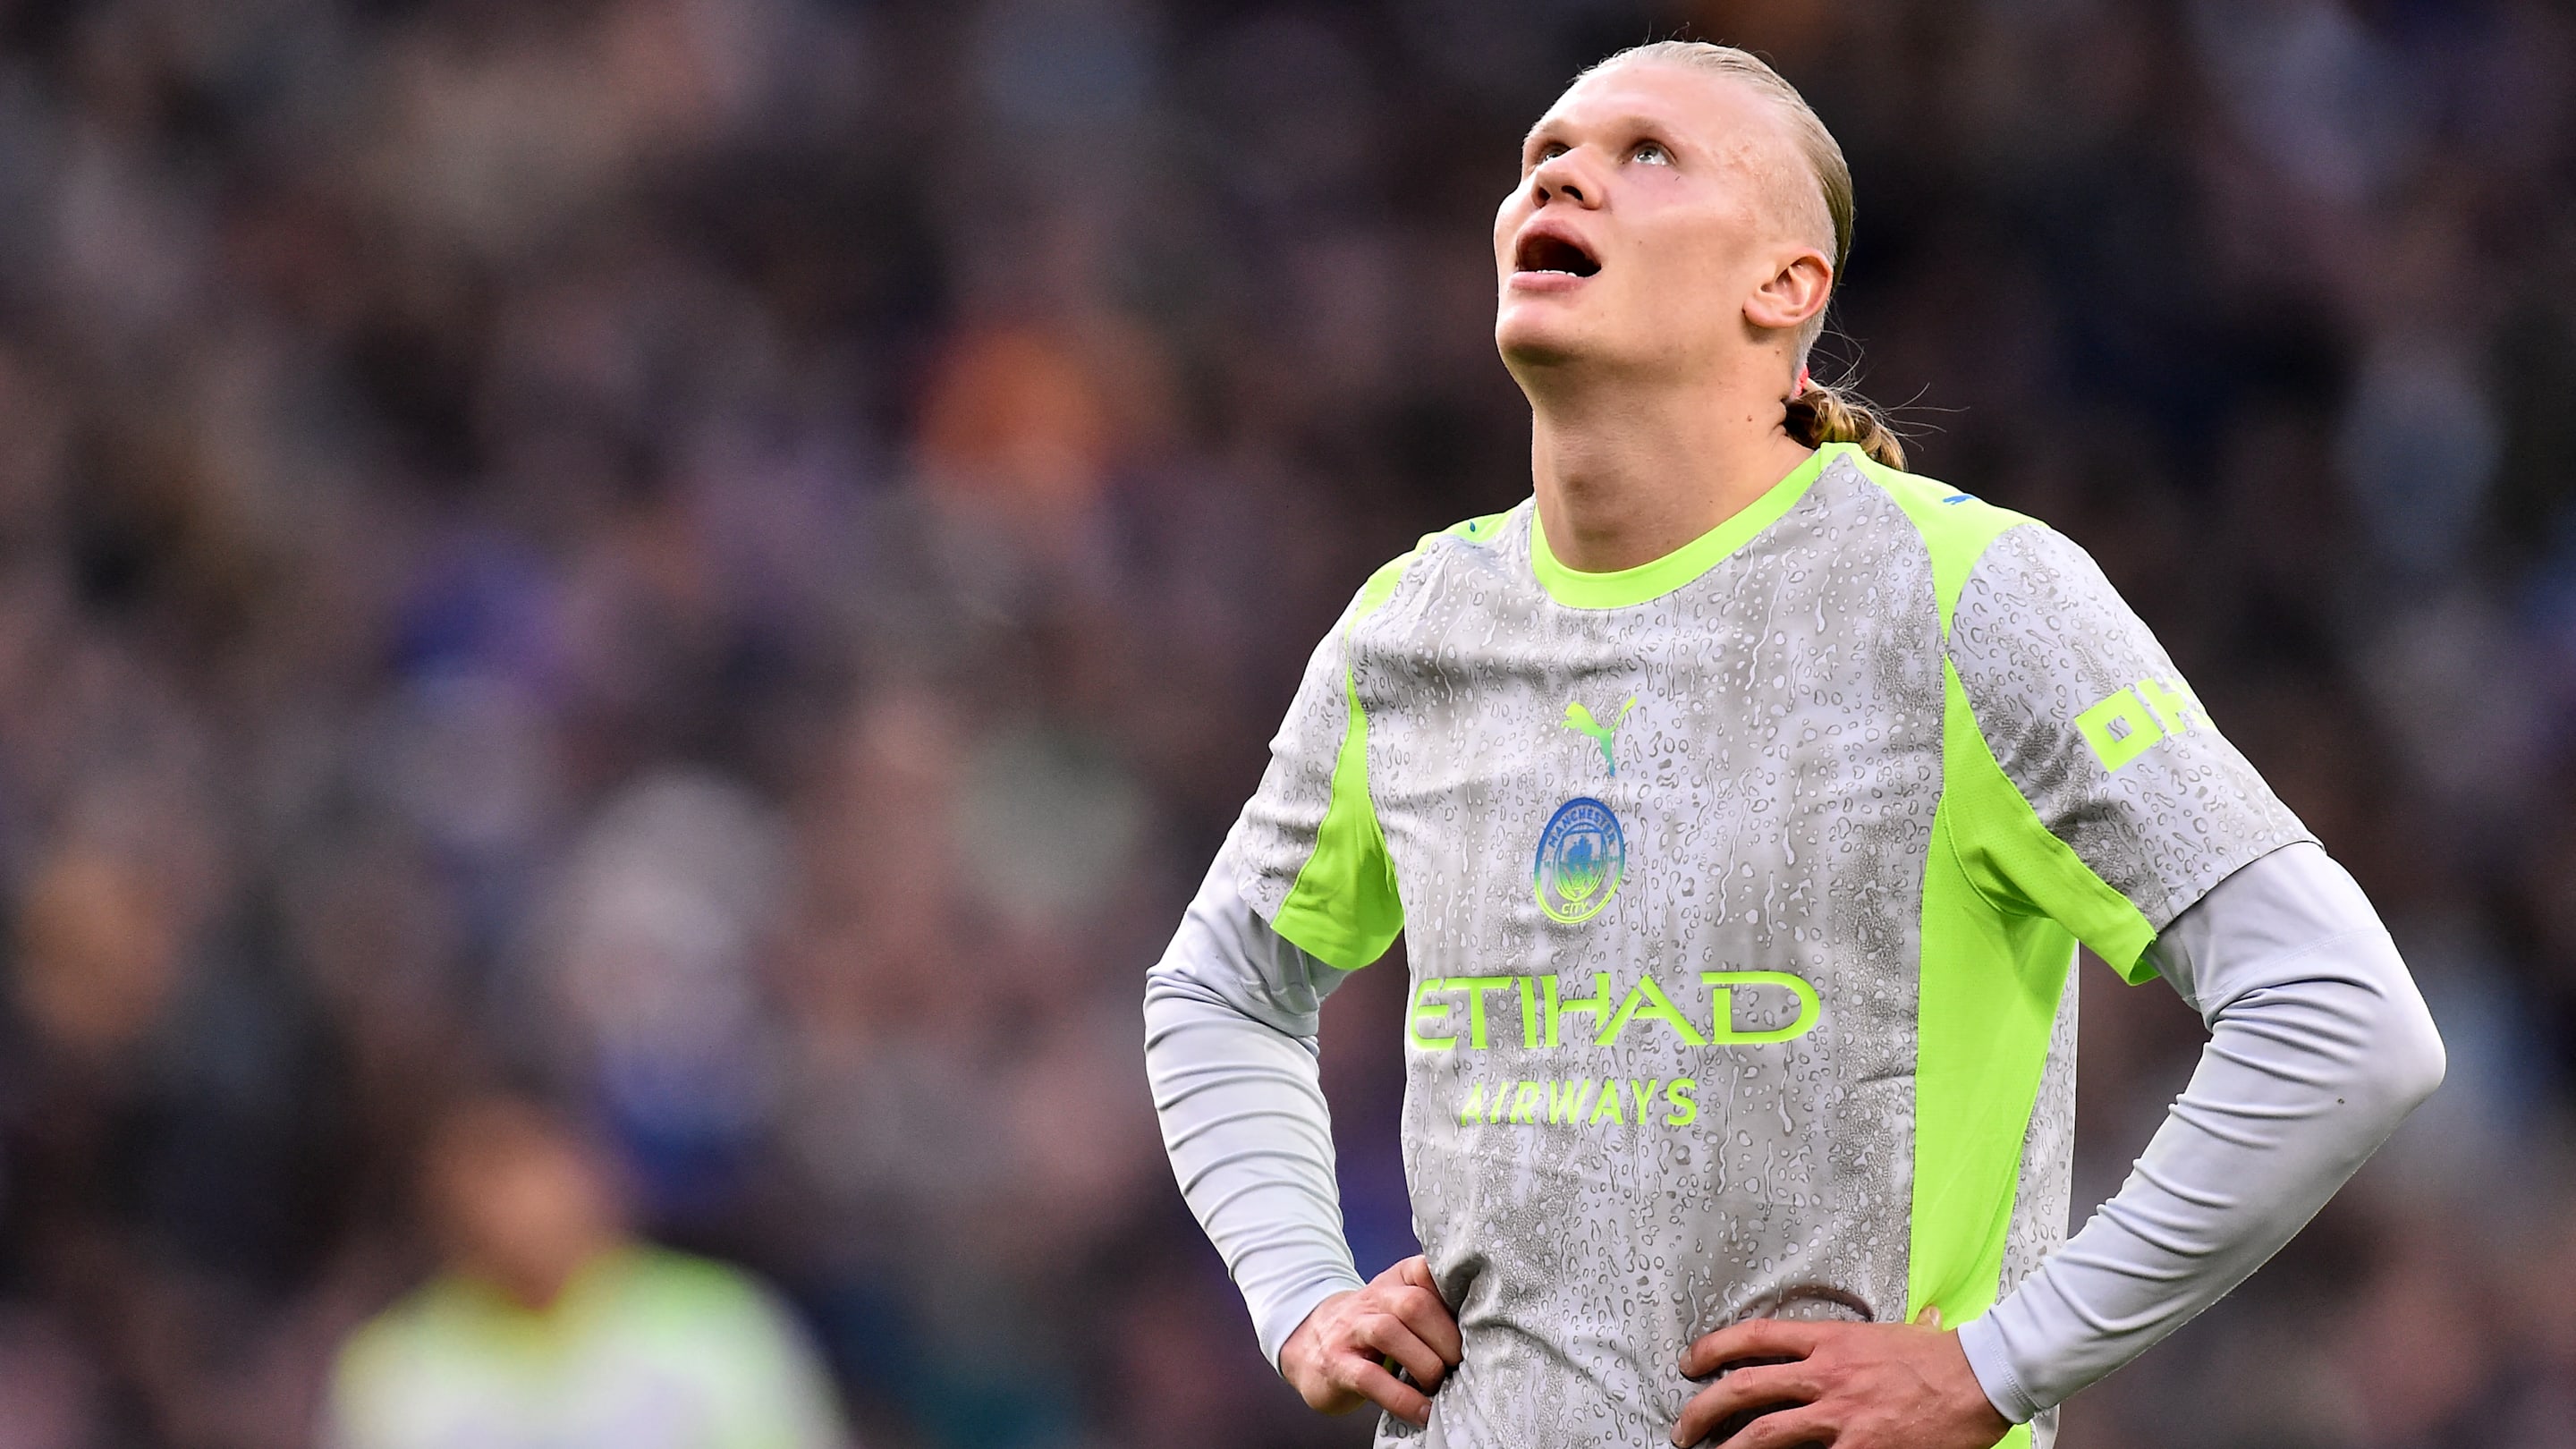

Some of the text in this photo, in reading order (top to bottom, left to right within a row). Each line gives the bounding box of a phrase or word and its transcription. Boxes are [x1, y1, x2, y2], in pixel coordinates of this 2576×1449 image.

[1547, 808, 1616, 848] MANCHESTER
[1561, 902, 1589, 915] CITY
[1408, 970, 1821, 1052] ETIHAD
[1460, 1077, 1698, 1127] AIRWAYS
